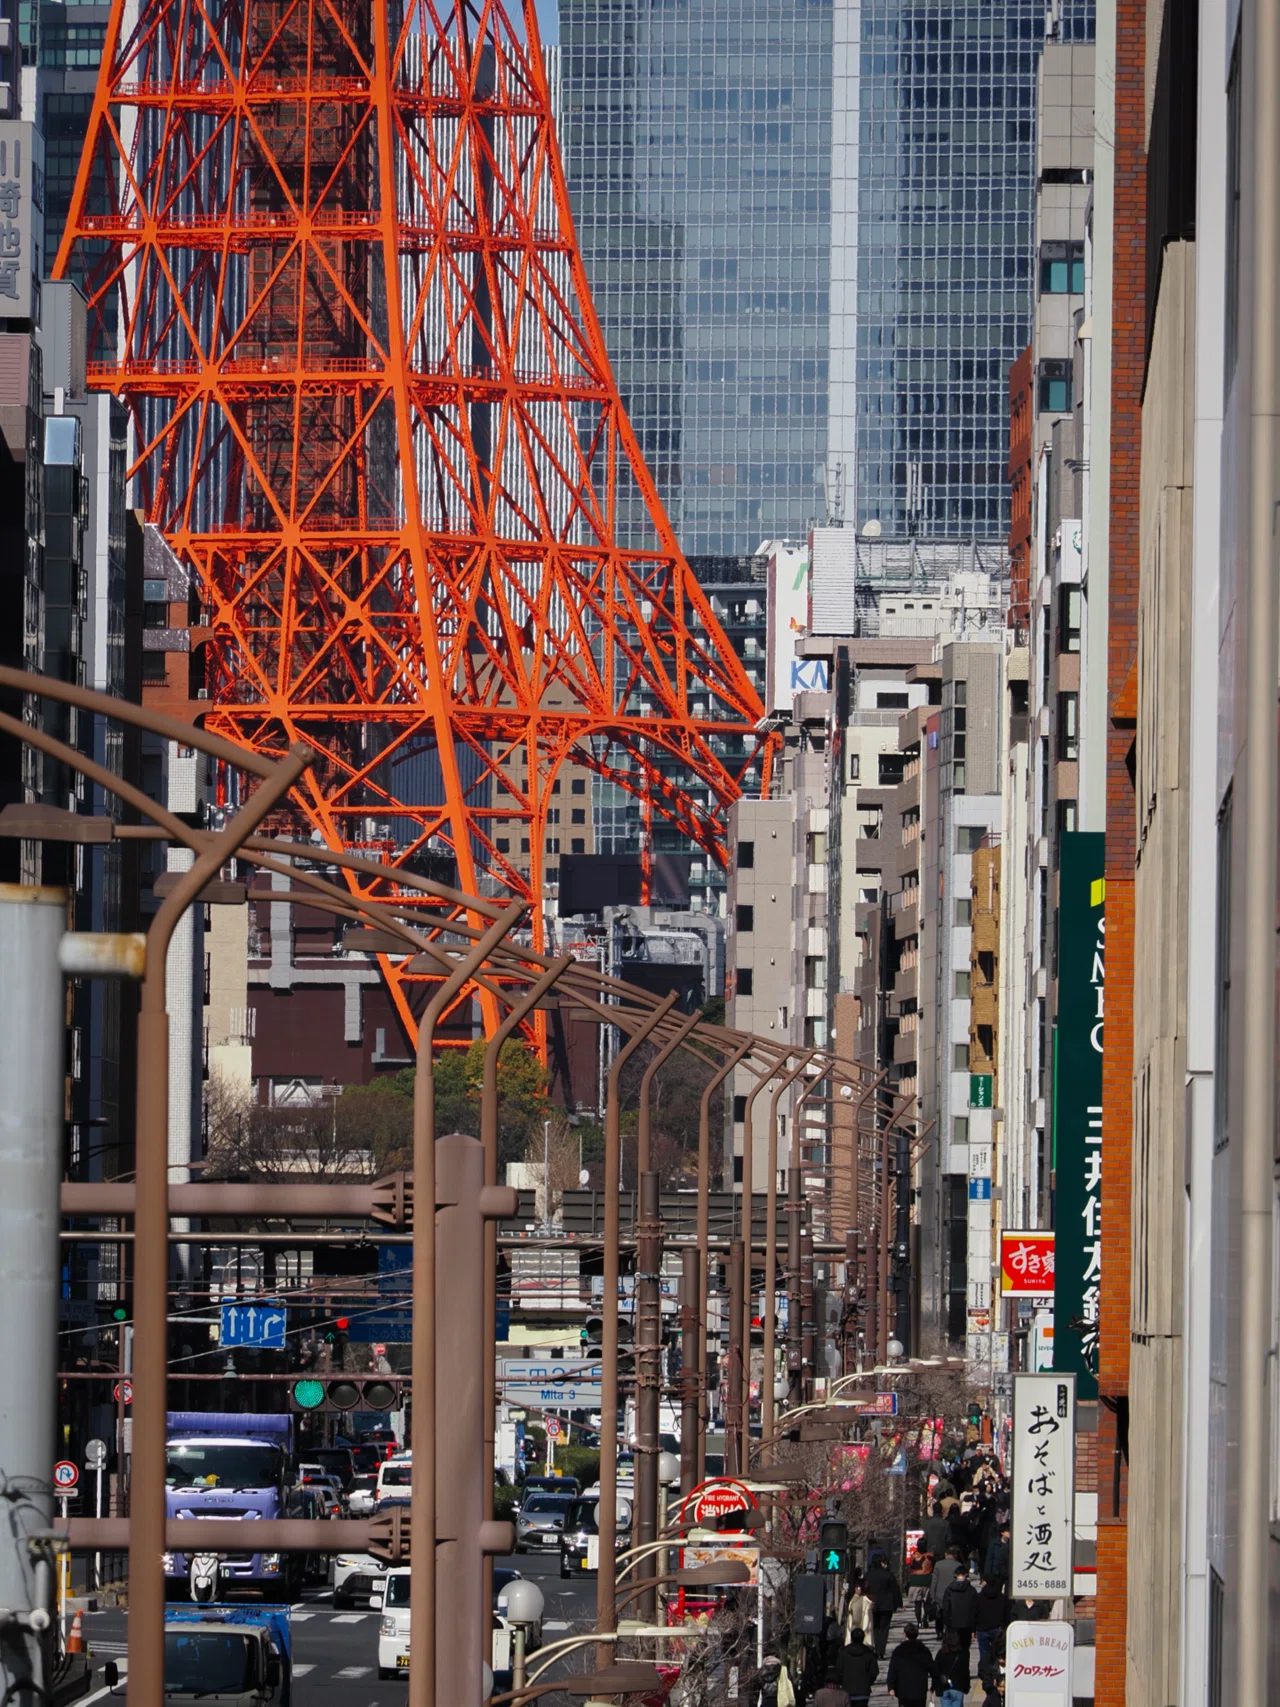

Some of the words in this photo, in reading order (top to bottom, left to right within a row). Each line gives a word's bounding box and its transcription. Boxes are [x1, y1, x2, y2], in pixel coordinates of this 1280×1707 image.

[1009, 1242, 1055, 1277] すき家
[1036, 1298, 1049, 1306] 2F
[541, 1389, 564, 1400] Mita
[569, 1389, 576, 1400] 3
[1016, 1580, 1067, 1589] 3455-6888
[1012, 1637, 1035, 1650] OVEN
[1039, 1637, 1068, 1651] BREAD
